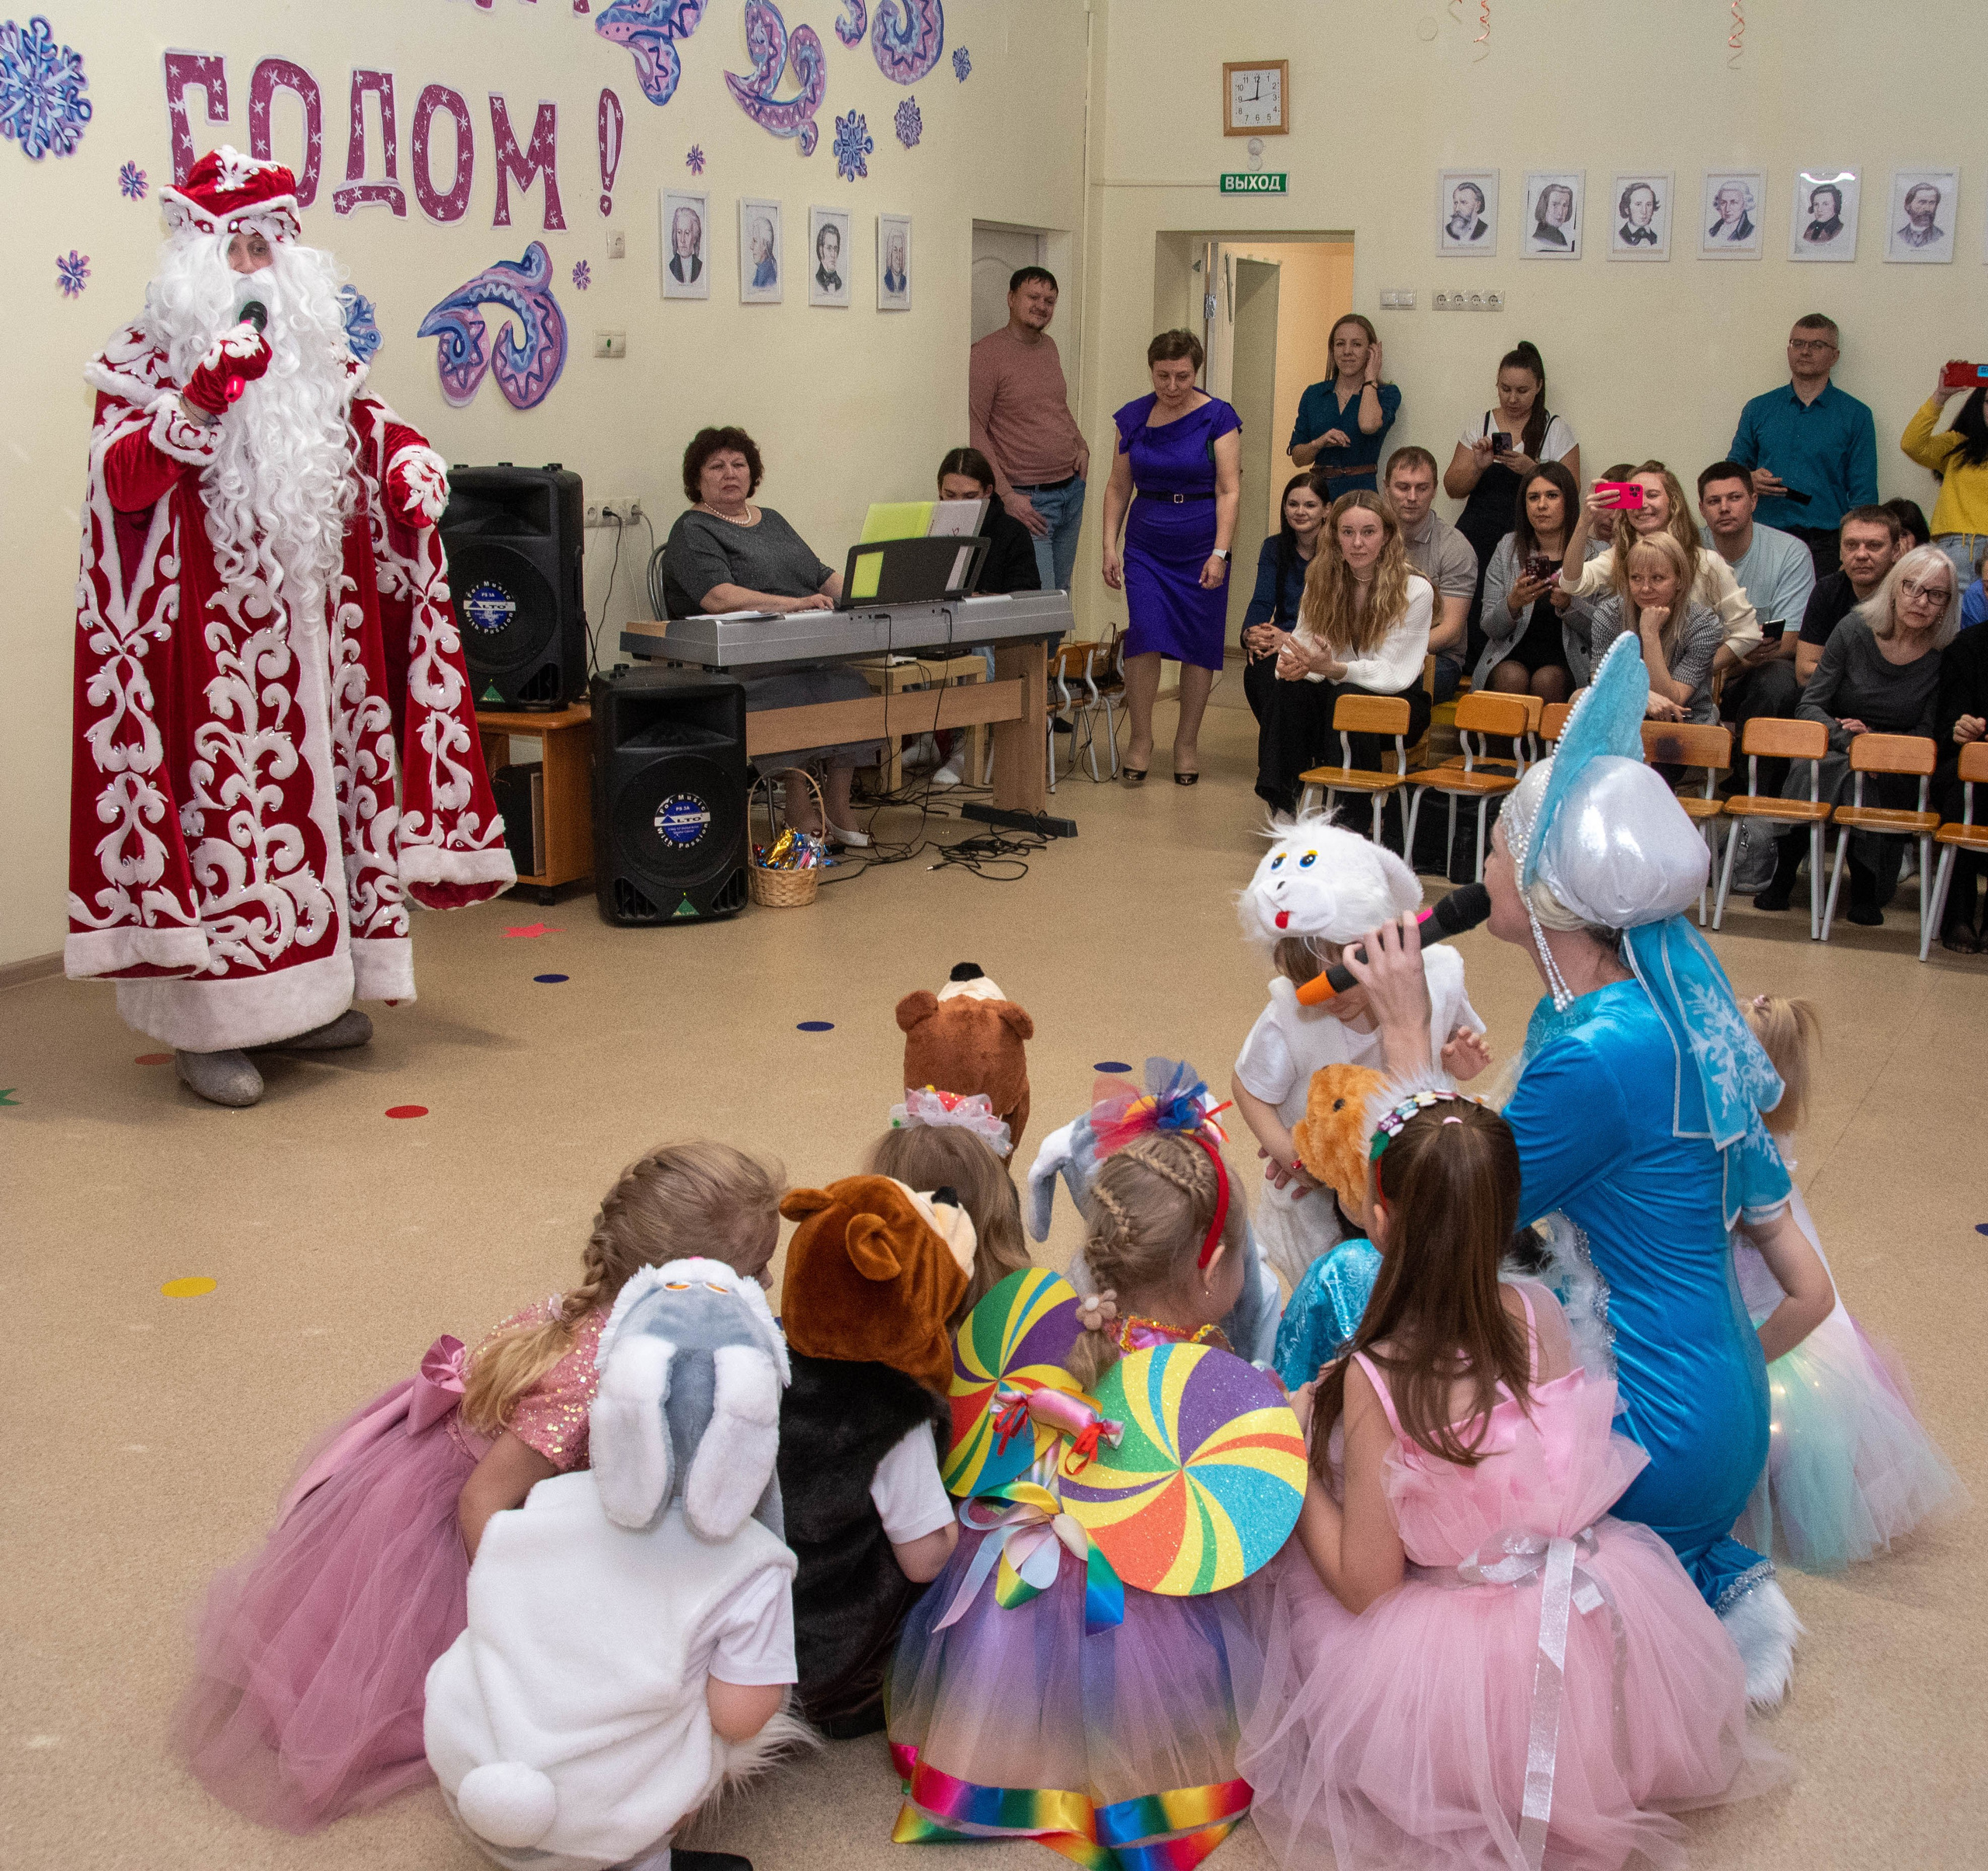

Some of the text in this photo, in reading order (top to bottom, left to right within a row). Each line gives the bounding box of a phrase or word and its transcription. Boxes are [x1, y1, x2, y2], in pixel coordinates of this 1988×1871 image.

[1225, 176, 1281, 191] ВЫХОД
[483, 580, 511, 600] Music
[466, 610, 513, 634] With Passion
[659, 794, 706, 814] For Music
[657, 822, 708, 849] With Passion
